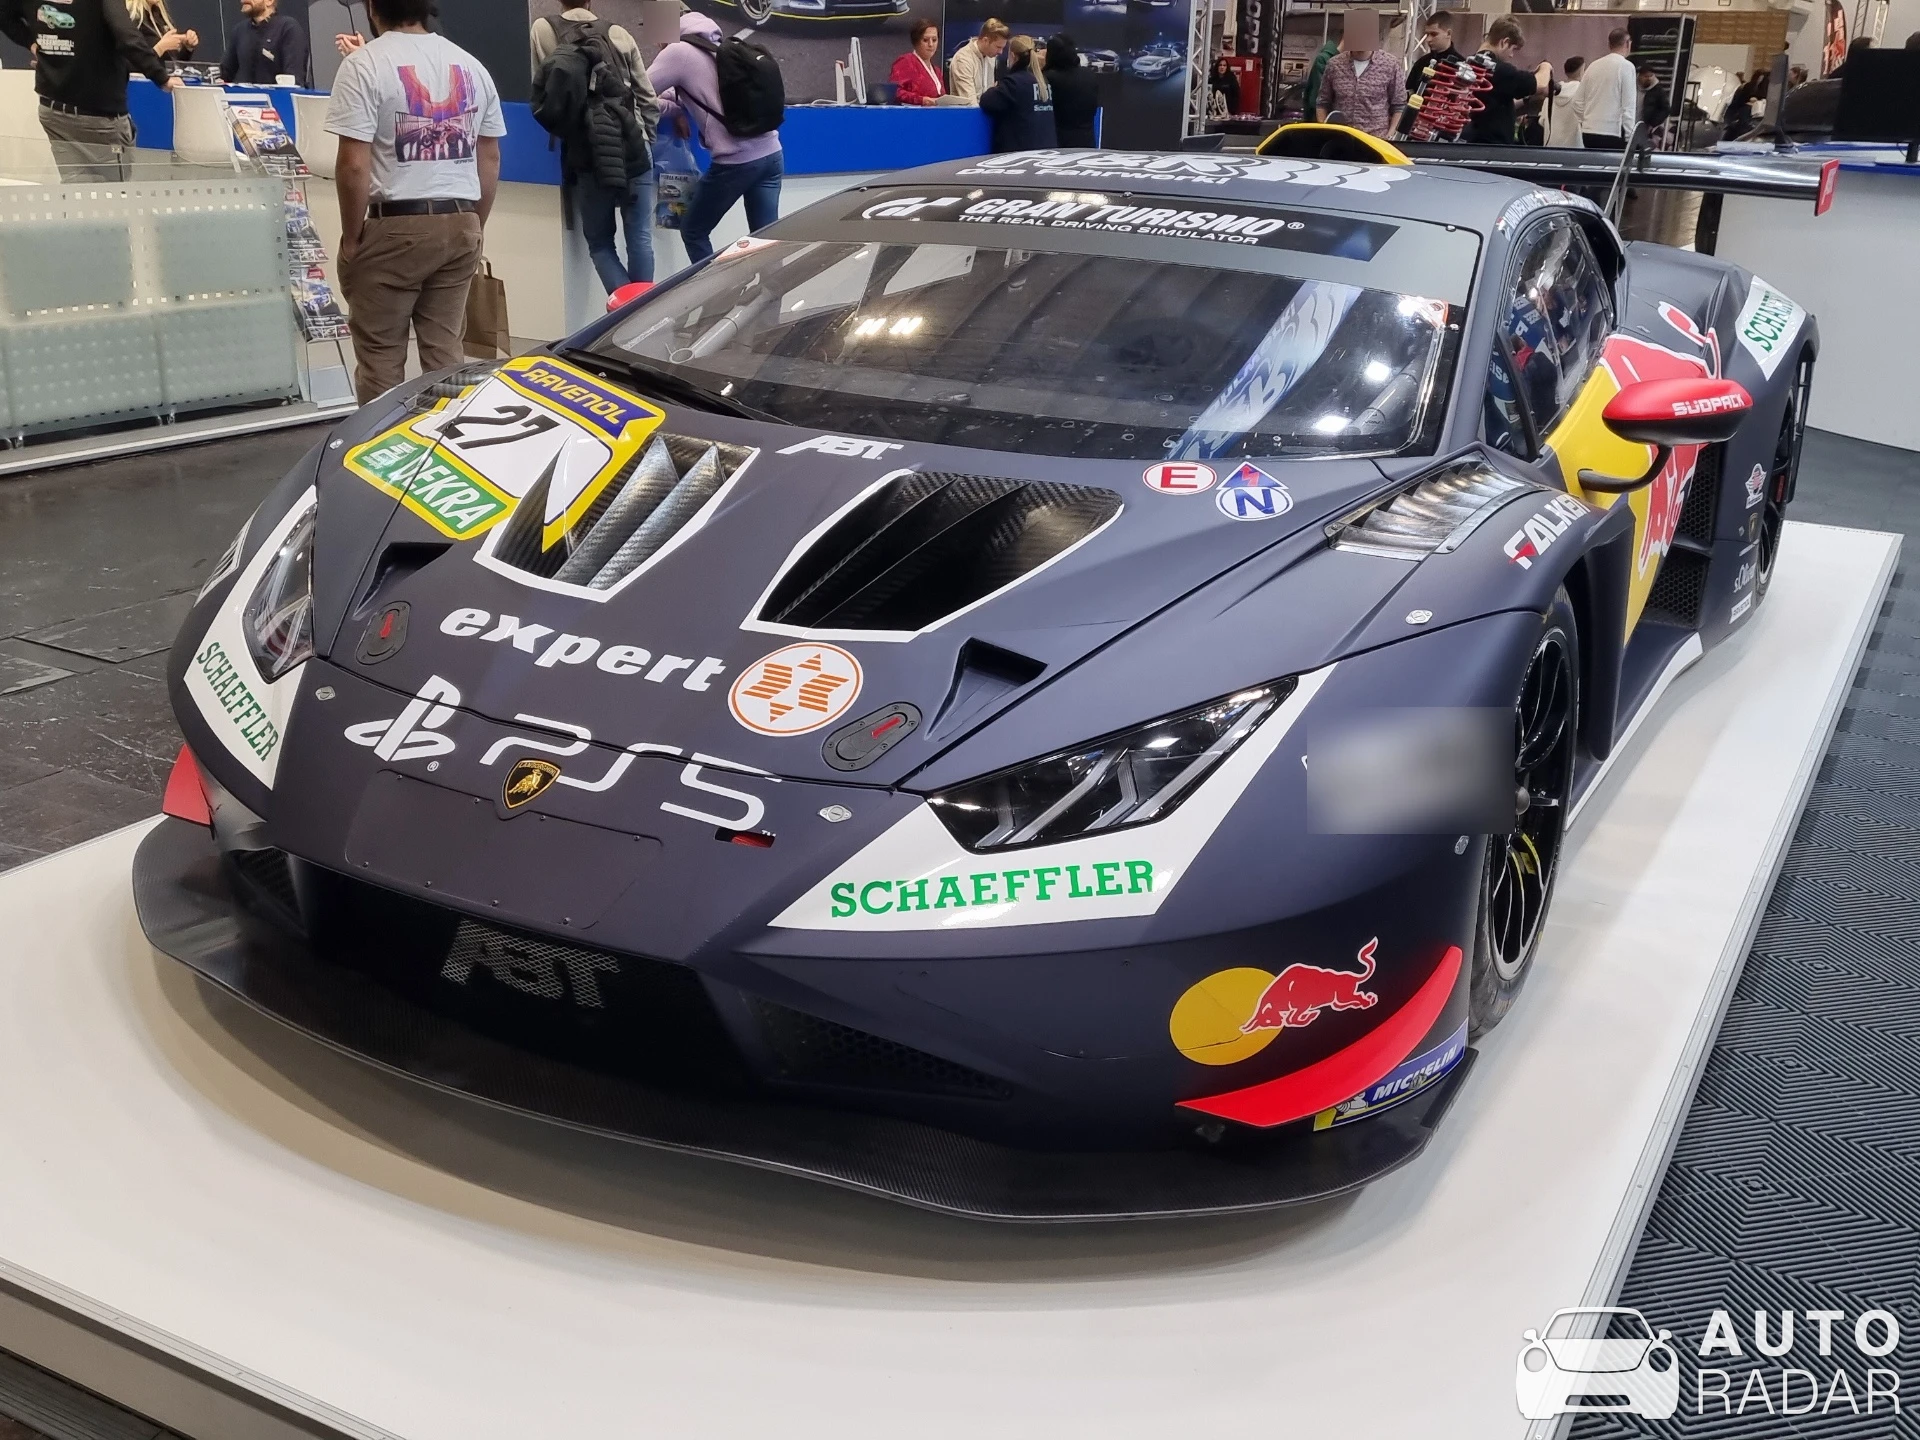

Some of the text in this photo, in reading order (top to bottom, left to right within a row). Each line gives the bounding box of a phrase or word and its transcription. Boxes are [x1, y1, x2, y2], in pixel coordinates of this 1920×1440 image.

[976, 150, 1243, 178] H&R
[958, 214, 1259, 245] THE REAL DRIVING SIMULATOR
[964, 197, 1083, 221] GRAN
[521, 367, 629, 425] RAVENOL
[435, 404, 561, 450] 27
[774, 434, 905, 460] ABT
[390, 452, 482, 531] DEKRA
[1160, 466, 1198, 489] E
[1234, 488, 1276, 517] N
[440, 606, 729, 692] expert
[196, 640, 280, 763] SCHAEFFLER
[479, 713, 783, 832] PS5
[830, 859, 1156, 919] SCHAEFFLER
[440, 918, 621, 1010] ABT
